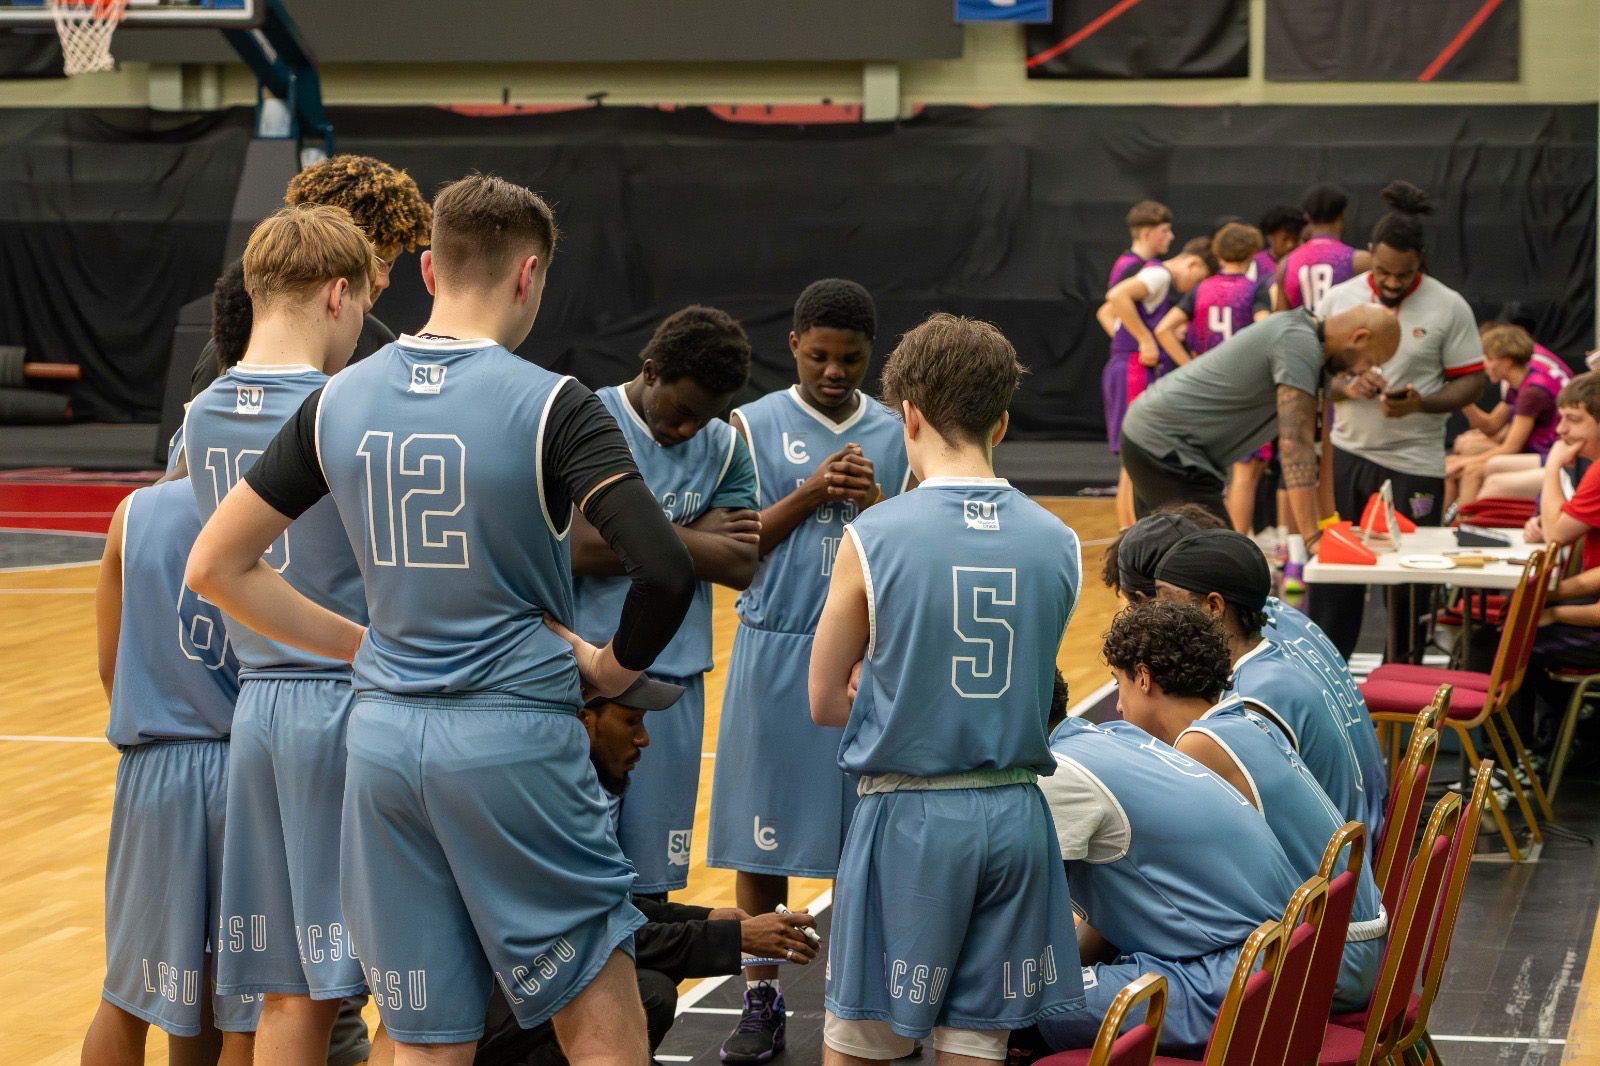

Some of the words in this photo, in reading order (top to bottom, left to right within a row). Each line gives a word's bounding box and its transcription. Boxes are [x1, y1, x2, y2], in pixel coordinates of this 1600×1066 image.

[1208, 305, 1232, 341] 4
[415, 367, 444, 385] SU
[239, 389, 262, 406] SU
[356, 431, 469, 568] 12
[967, 502, 995, 520] SU
[952, 566, 1016, 698] 5
[142, 958, 198, 1006] LCSU
[884, 951, 947, 1005] CSU
